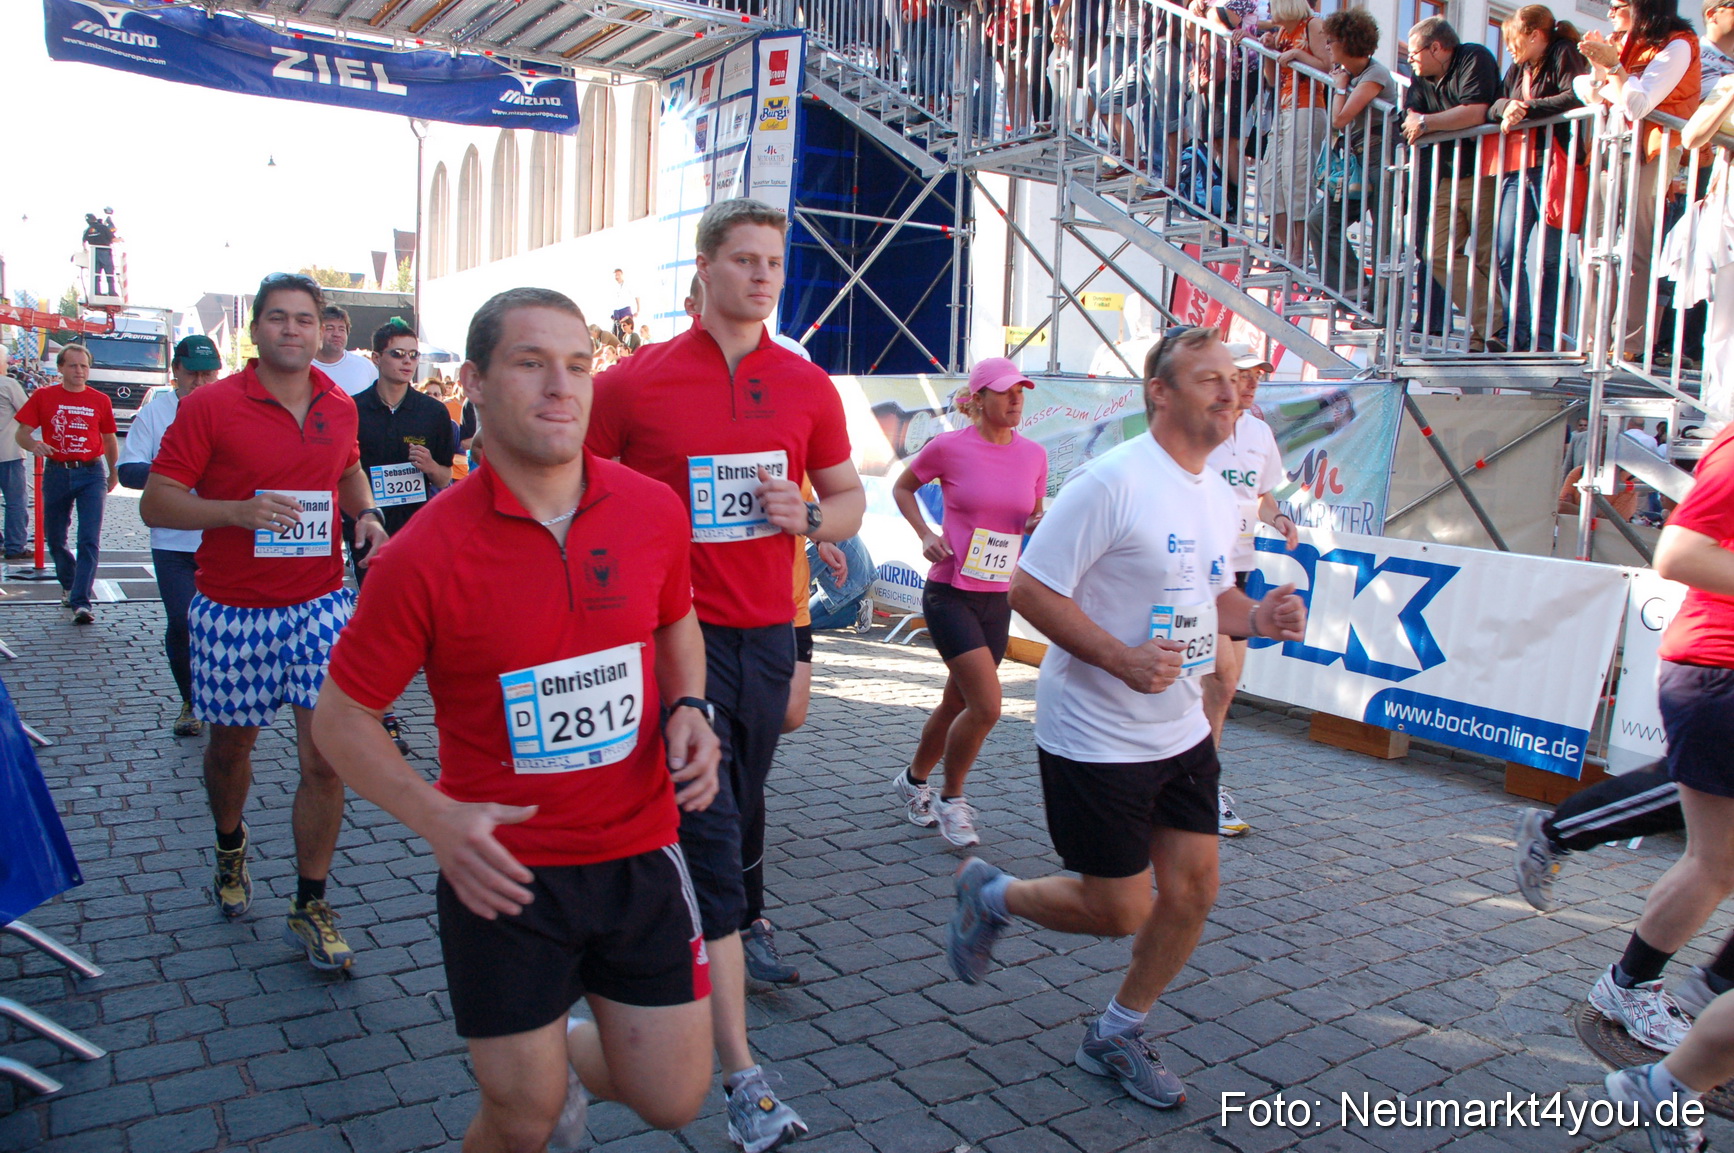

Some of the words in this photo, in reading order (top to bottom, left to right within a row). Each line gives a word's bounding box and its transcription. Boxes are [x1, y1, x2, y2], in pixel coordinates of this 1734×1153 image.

[62, 37, 167, 65] www.mizunoeurope.com
[271, 46, 408, 96] ZIEL
[1065, 407, 1089, 421] zum
[1093, 389, 1133, 421] Leben
[387, 479, 422, 494] 3202
[698, 489, 709, 502] D
[721, 491, 766, 517] 29
[279, 520, 328, 540] 2014
[972, 546, 980, 555] D
[987, 537, 1009, 548] Nicole
[984, 553, 1008, 569] 115
[1174, 615, 1198, 628] Uwe
[1177, 634, 1213, 659] 629
[541, 662, 628, 696] Christian
[515, 710, 532, 728] D
[549, 694, 636, 743] 2812
[1384, 700, 1580, 762] www.bockonline.de
